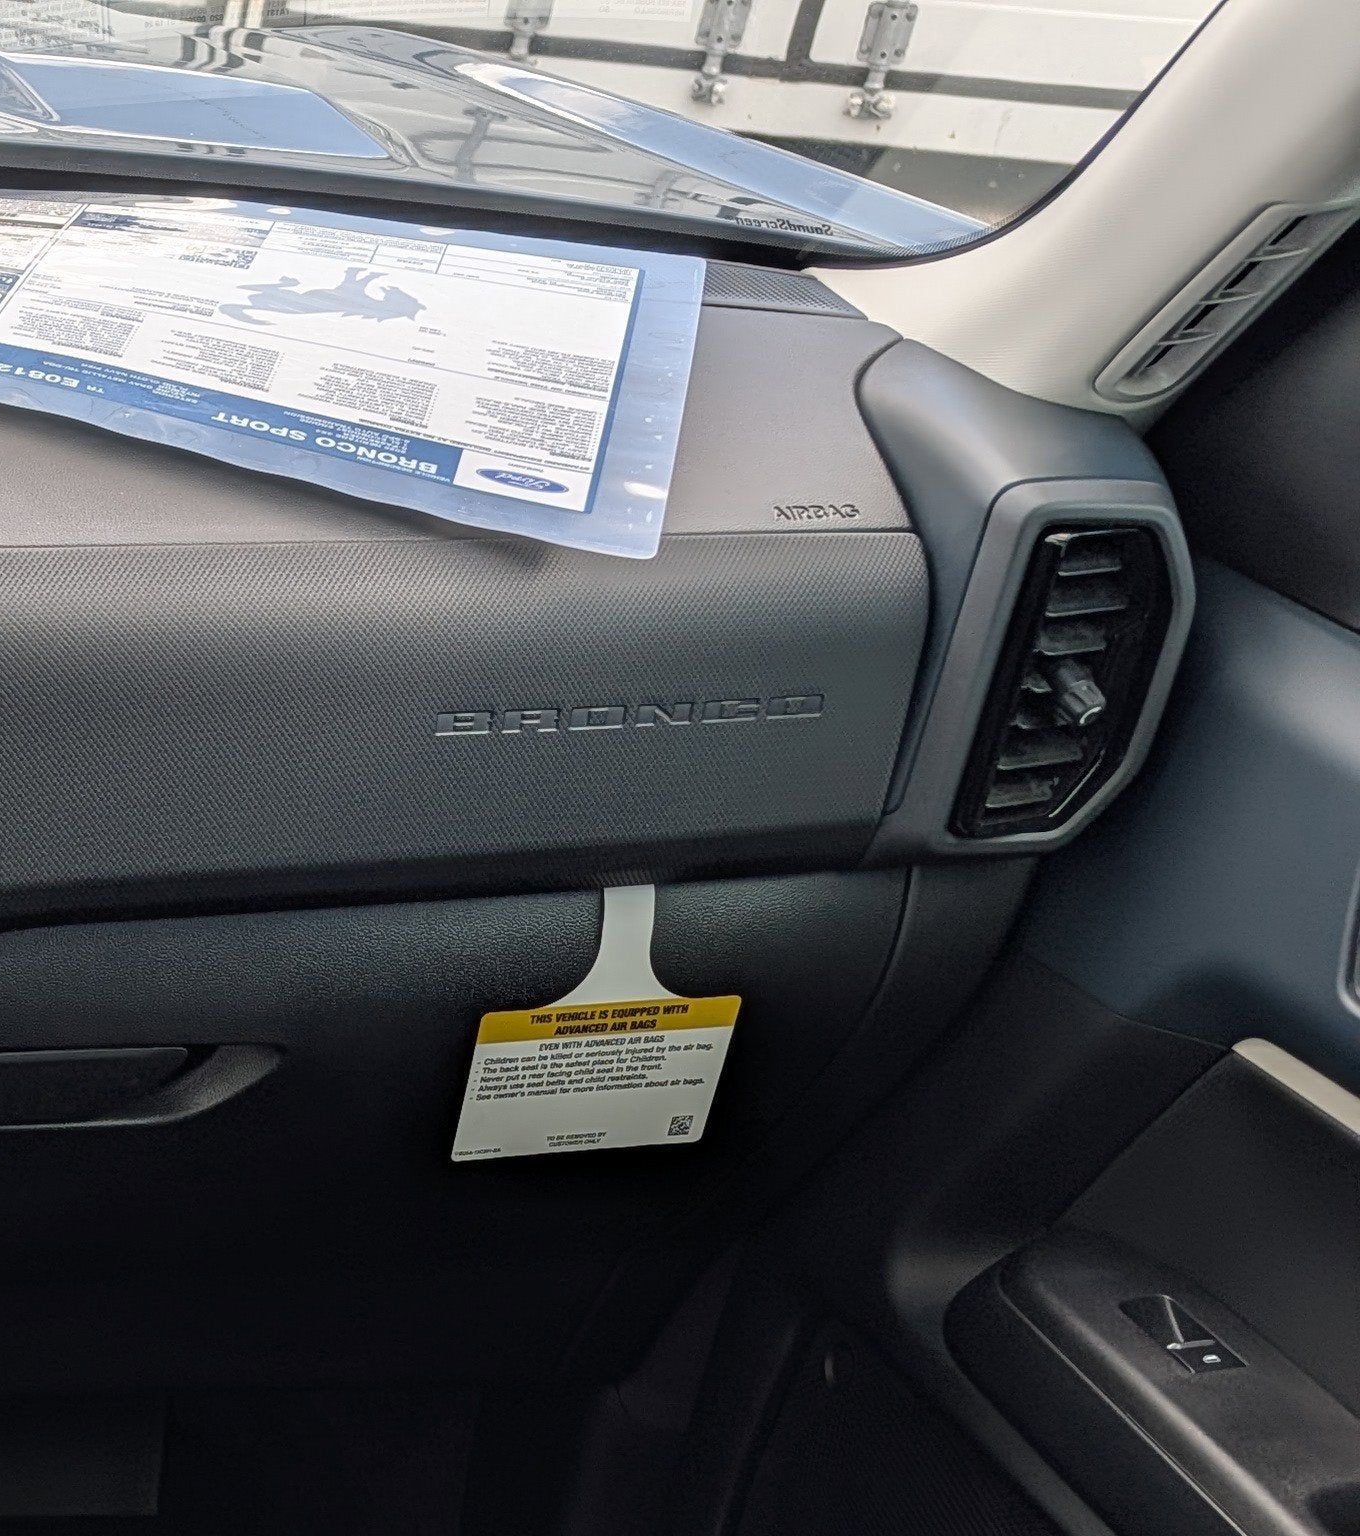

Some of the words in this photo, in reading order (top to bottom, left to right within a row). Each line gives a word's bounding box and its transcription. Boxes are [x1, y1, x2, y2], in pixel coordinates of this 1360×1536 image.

[211, 411, 308, 442] SPORT
[314, 436, 439, 474] BRONCO
[773, 504, 860, 520] AIRBAG
[435, 693, 826, 737] BRONCO
[530, 1013, 553, 1024] THIS
[556, 1010, 596, 1022] VEHICLE
[598, 1010, 609, 1020] IS
[611, 1005, 660, 1018] EQUIPPED
[662, 1004, 689, 1014] WITH
[554, 1022, 608, 1036] ADVANCED
[610, 1020, 628, 1032] AIR
[630, 1019, 658, 1030] BAGS
[538, 1042, 560, 1052] EVEN
[561, 1040, 582, 1050] WITH
[583, 1038, 626, 1048] ADVANCED
[628, 1036, 642, 1045] AIR
[643, 1035, 665, 1044] BAGS
[484, 1056, 520, 1066] Children
[538, 1052, 548, 1062] be
[550, 1051, 572, 1060] killed
[585, 1048, 624, 1058] seriously
[625, 1046, 654, 1057] injured
[656, 1045, 666, 1054] by
[668, 1043, 682, 1052] the
[682, 1042, 694, 1051] air
[480, 1076, 505, 1084] Never
[506, 1074, 520, 1084] put
[528, 1072, 544, 1080] rear
[546, 1070, 572, 1080] facing
[574, 1066, 595, 1076] child
[596, 1066, 614, 1074] seat
[626, 1064, 638, 1072] the
[482, 1066, 500, 1074] The
[500, 1064, 519, 1073] back
[521, 1062, 539, 1072] seat
[550, 1061, 564, 1069] the
[591, 1057, 614, 1067] place
[616, 1056, 628, 1064] for
[476, 1093, 492, 1102] See
[527, 1088, 558, 1097] manual
[560, 1087, 571, 1095] for
[596, 1082, 642, 1092] information
[644, 1080, 668, 1088] about
[478, 1082, 508, 1092] Always
[526, 1080, 544, 1088] seat
[546, 1078, 566, 1087] belts
[568, 1076, 584, 1086] and
[585, 1075, 607, 1084] child
